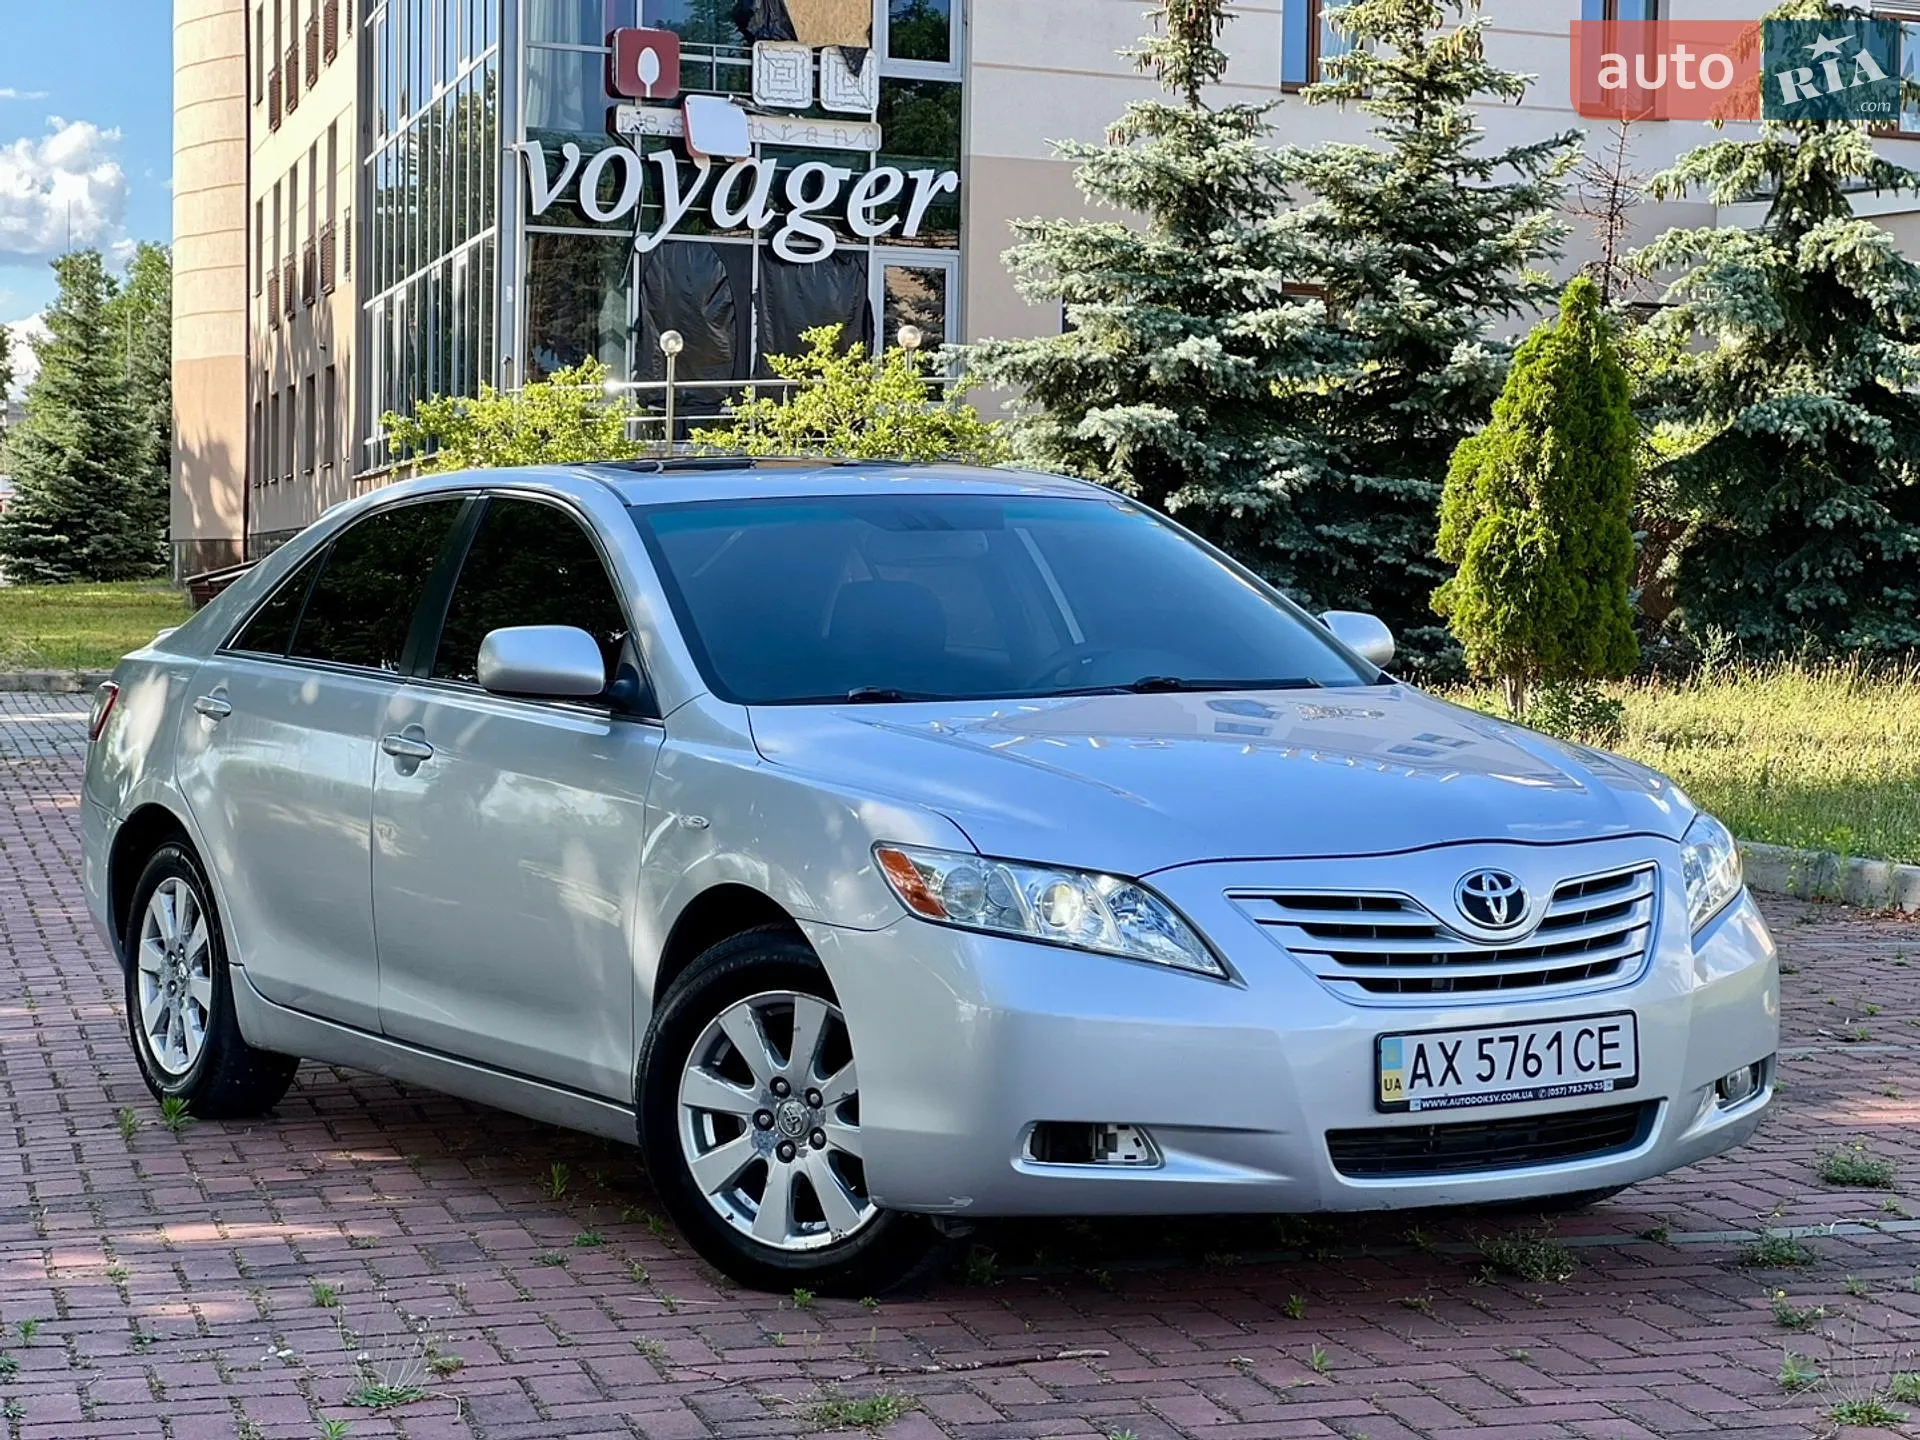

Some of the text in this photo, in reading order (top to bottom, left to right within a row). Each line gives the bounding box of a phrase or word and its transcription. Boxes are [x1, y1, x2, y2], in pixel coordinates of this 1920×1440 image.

[619, 109, 878, 148] resurant
[518, 139, 959, 264] voyager
[1409, 1024, 1622, 1089] AX 5761 CE
[1383, 1079, 1403, 1092] UA
